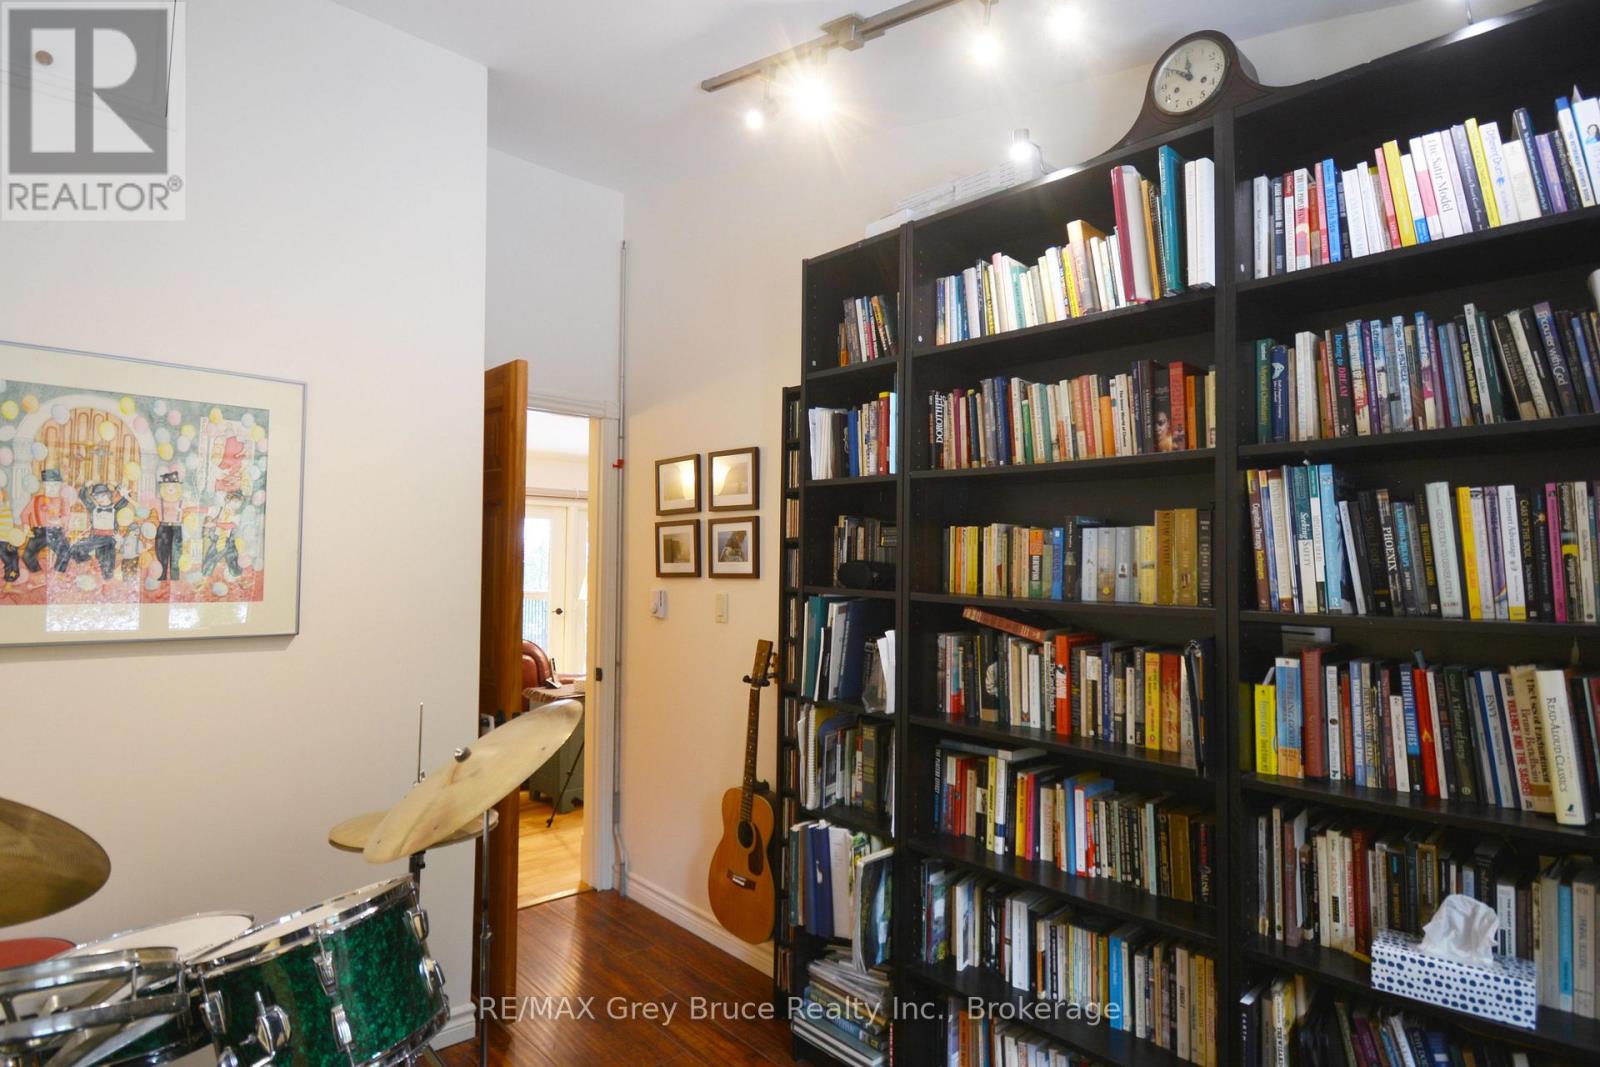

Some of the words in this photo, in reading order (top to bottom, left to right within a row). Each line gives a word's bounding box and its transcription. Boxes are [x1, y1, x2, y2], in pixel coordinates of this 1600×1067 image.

[1432, 157, 1445, 180] Satir
[1437, 181, 1454, 213] Model
[1537, 311, 1554, 347] Encounter
[1548, 348, 1562, 366] with
[1337, 367, 1348, 397] DREAM
[1553, 366, 1568, 386] God
[1251, 503, 1261, 528] Cognitive
[1299, 511, 1311, 539] Seeking
[1254, 528, 1262, 549] Therapy
[1383, 527, 1397, 572] PHOENIX
[1302, 541, 1313, 567] SAFETY
[1400, 671, 1414, 709] EMOTIONAL
[1485, 694, 1497, 719] ENVY
[1508, 700, 1522, 732] VIOLENCE
[1405, 713, 1417, 745] VAMPIRES
[1513, 735, 1525, 750] AND
[1546, 697, 1562, 754] READ-ALOUD
[1554, 755, 1568, 793] CLASSICS
[1516, 753, 1528, 766] THE
[1519, 768, 1533, 796] SACRED
